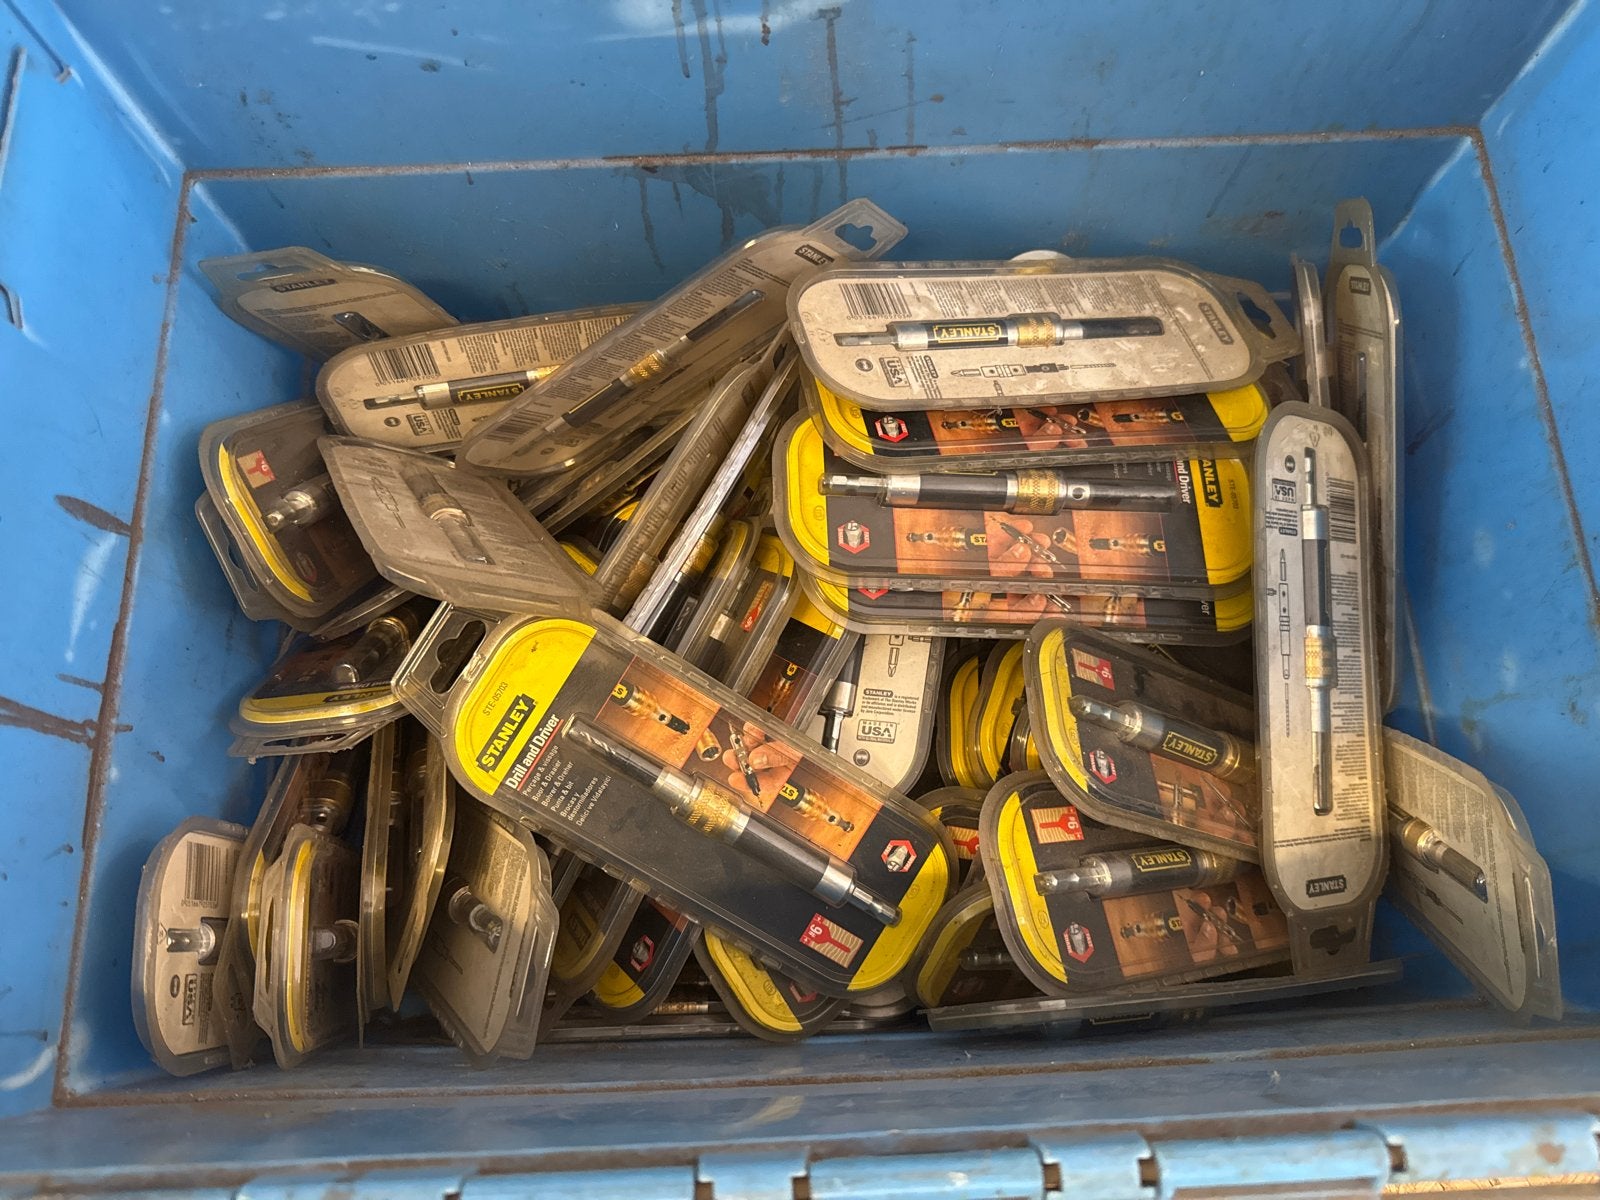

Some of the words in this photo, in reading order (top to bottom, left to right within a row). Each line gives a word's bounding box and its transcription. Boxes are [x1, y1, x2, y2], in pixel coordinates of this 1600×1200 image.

[798, 246, 828, 264] STANLE
[941, 327, 995, 337] STANLEY
[1201, 304, 1232, 343] STANLEY
[887, 360, 902, 384] USA
[467, 387, 520, 401] STANLEY
[414, 416, 427, 433] USA
[1179, 475, 1191, 503] Driver
[1275, 485, 1293, 497] USA
[482, 680, 509, 717] STE-05703
[480, 698, 529, 769] STANLEY
[861, 725, 892, 737] USA
[505, 764, 528, 790] Drill
[520, 744, 541, 767] and
[532, 713, 560, 747] Driver
[1168, 738, 1213, 762] STANLEY
[522, 771, 543, 797] Perçage
[538, 765, 546, 773] &
[542, 744, 560, 768] vissage
[532, 786, 545, 802] Boor
[541, 780, 549, 788] &
[545, 759, 562, 782] Draaier
[541, 786, 558, 807] Bohrer
[557, 760, 574, 782] Dreher
[551, 794, 565, 812] Punta
[561, 788, 569, 796] &
[565, 780, 574, 790] bit
[560, 795, 577, 818] Brocas
[567, 775, 599, 822] destornilladores
[576, 808, 591, 827] Delici
[587, 802, 596, 811] ve
[1066, 816, 1079, 830] #6
[1139, 852, 1186, 865] STANLEY
[1309, 879, 1344, 893] STANLEY
